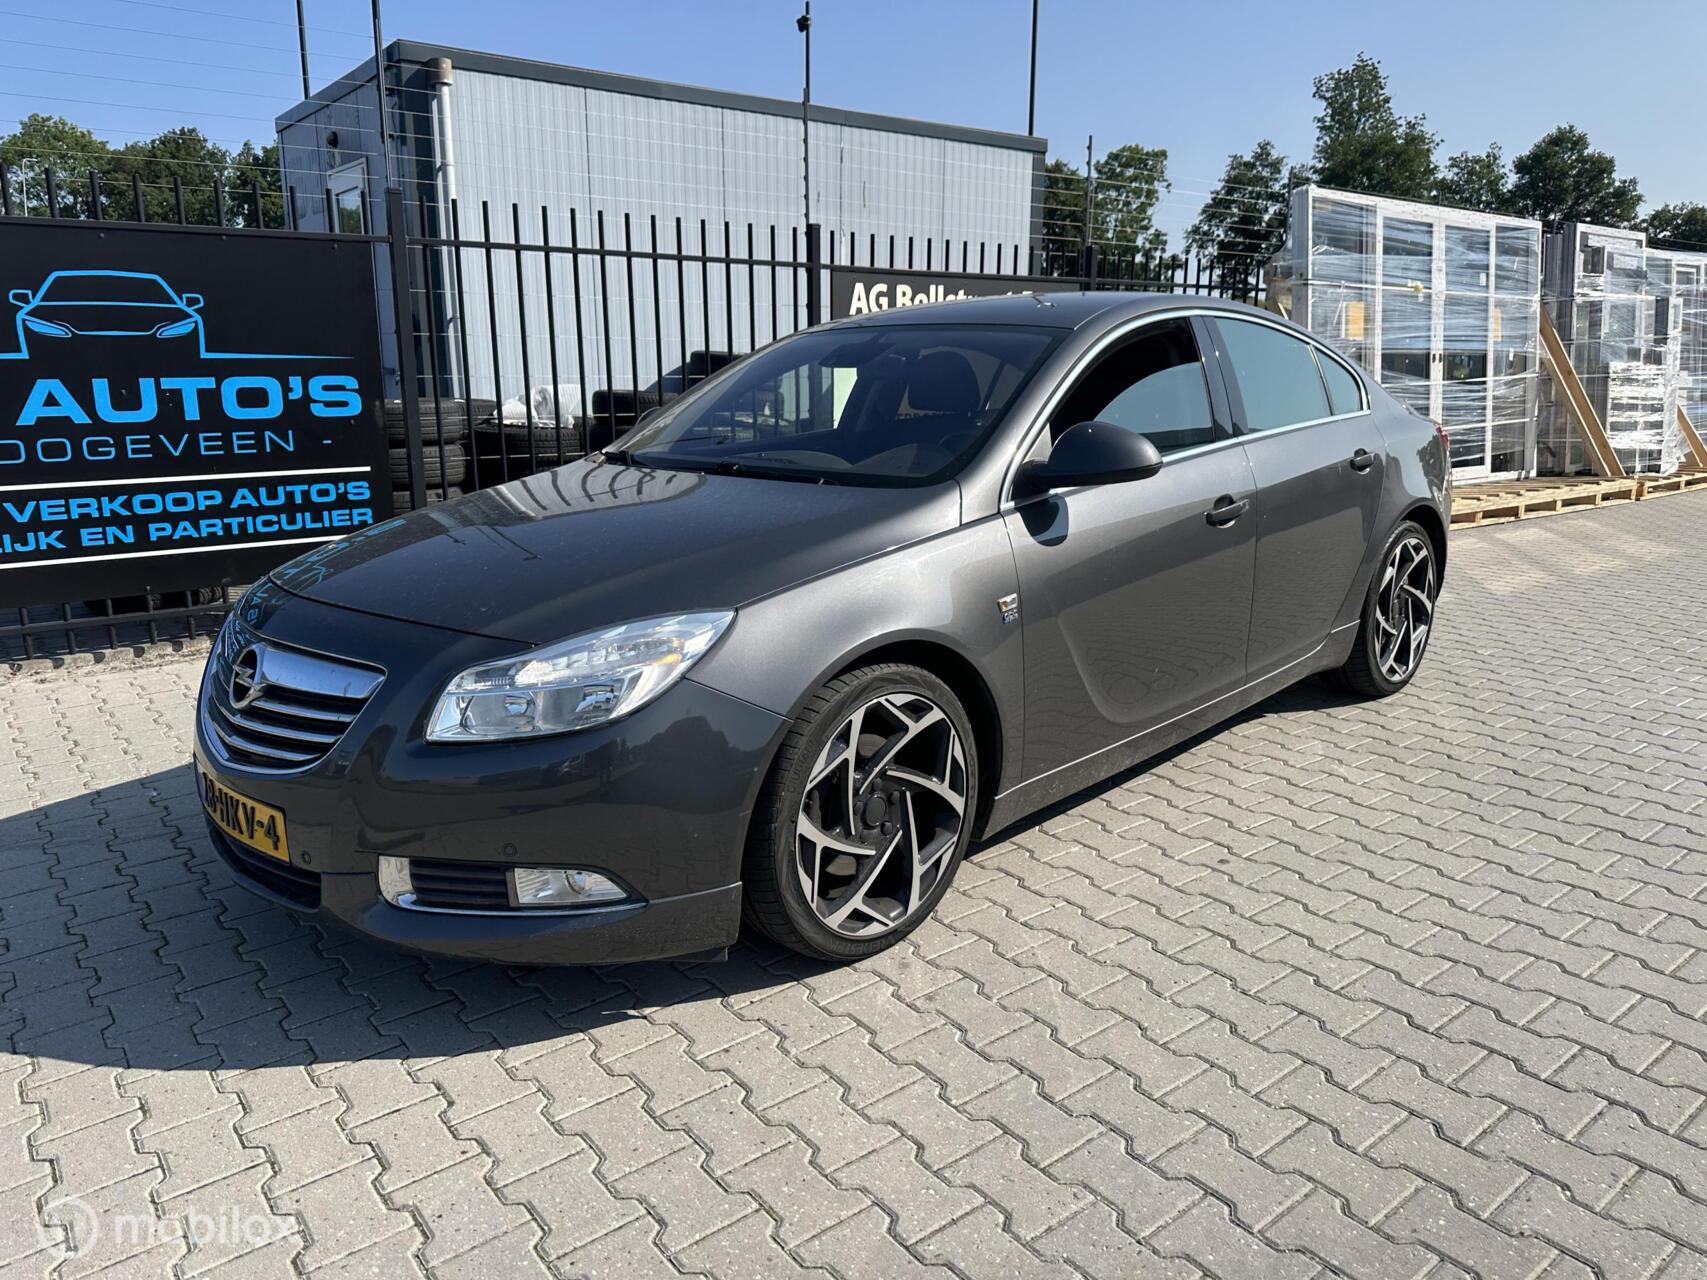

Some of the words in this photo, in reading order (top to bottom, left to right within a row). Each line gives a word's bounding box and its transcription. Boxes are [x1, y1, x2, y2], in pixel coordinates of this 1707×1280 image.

[849, 282, 889, 315] AG
[16, 376, 363, 425] AUTO'S
[3, 490, 222, 523] VERKOOP
[230, 480, 371, 509] AUTO'S
[0, 529, 66, 554] IJK
[80, 525, 135, 547] EN
[149, 508, 374, 542] PARTICULIER
